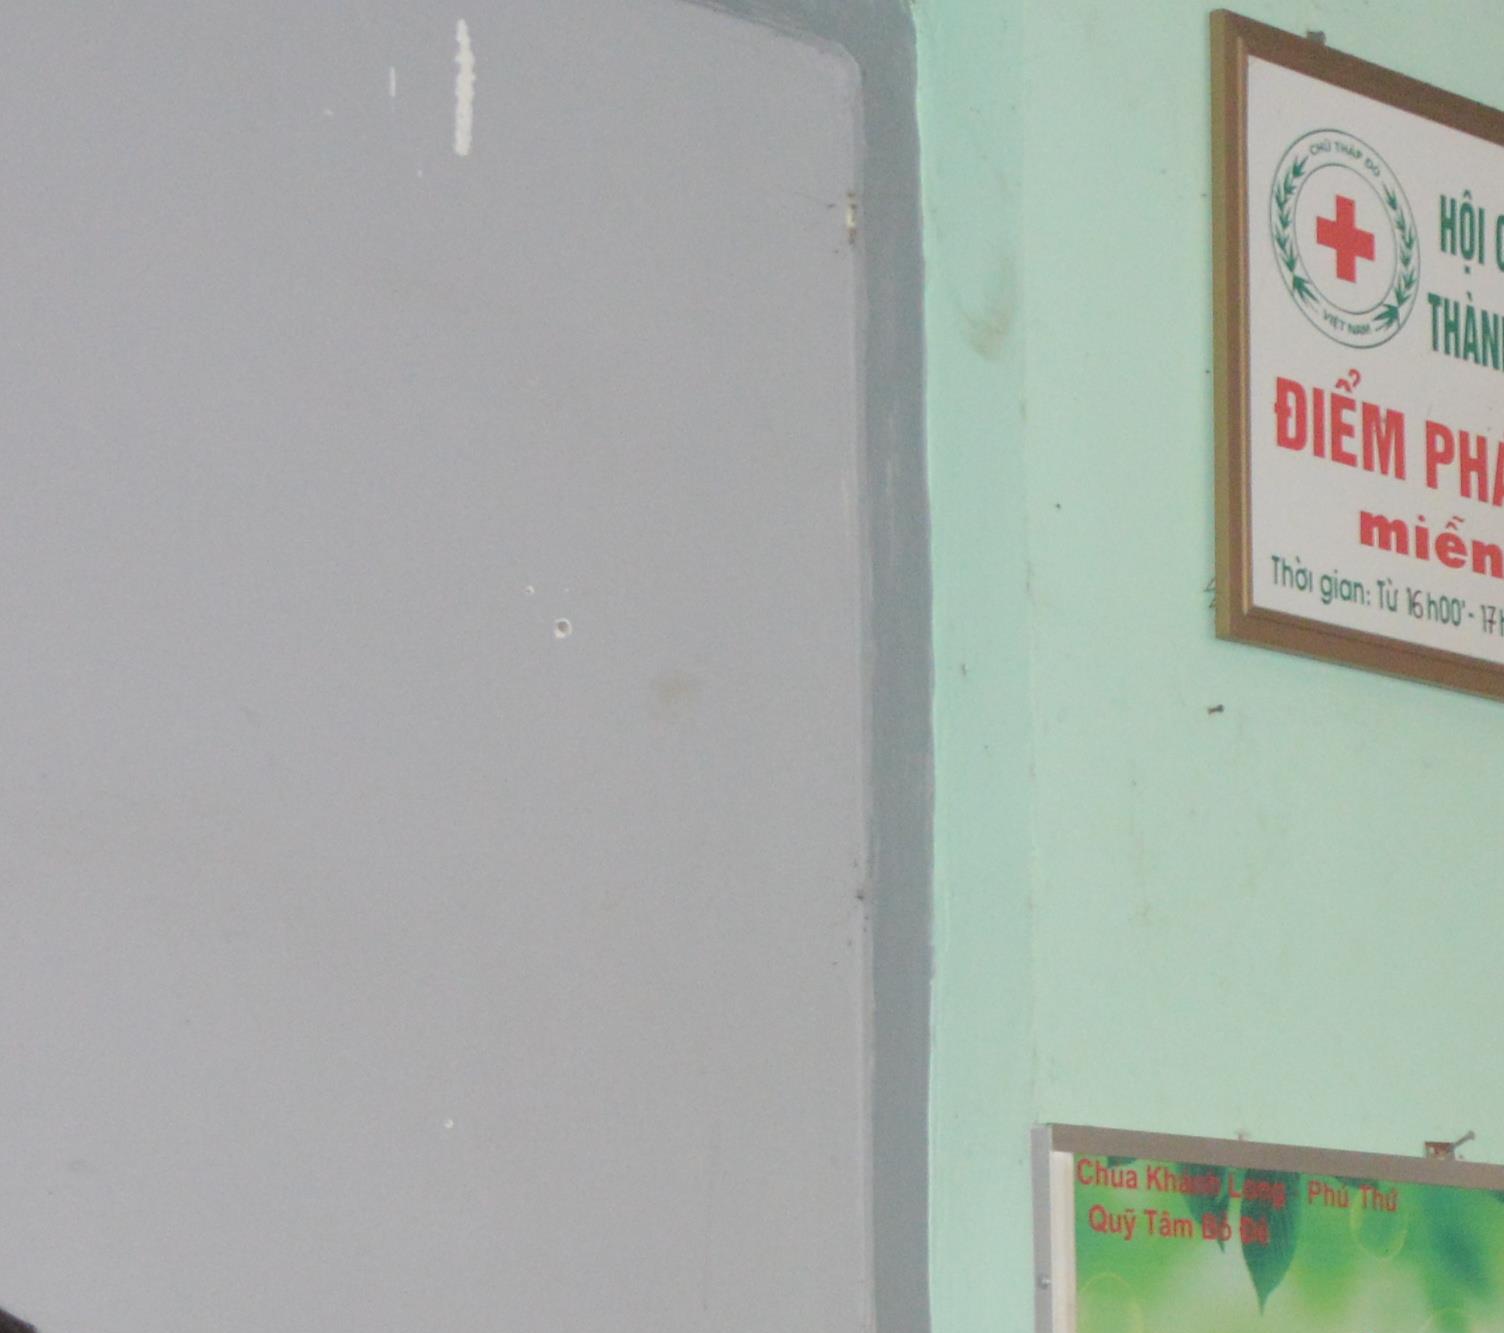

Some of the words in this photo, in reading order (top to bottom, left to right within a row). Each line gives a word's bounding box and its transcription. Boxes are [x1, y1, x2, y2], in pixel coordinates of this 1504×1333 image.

[1439, 189, 1486, 274] HỘI
[1273, 368, 1406, 481] ĐIỂM
[1359, 509, 1504, 579] miễn
[1271, 555, 1313, 592] Thời
[1320, 569, 1371, 605] gian:
[1377, 578, 1399, 612] Từ
[1088, 1204, 1137, 1241] Quỹ
[1145, 1207, 1194, 1239] Tâm
[1227, 1172, 1286, 1210] Long
